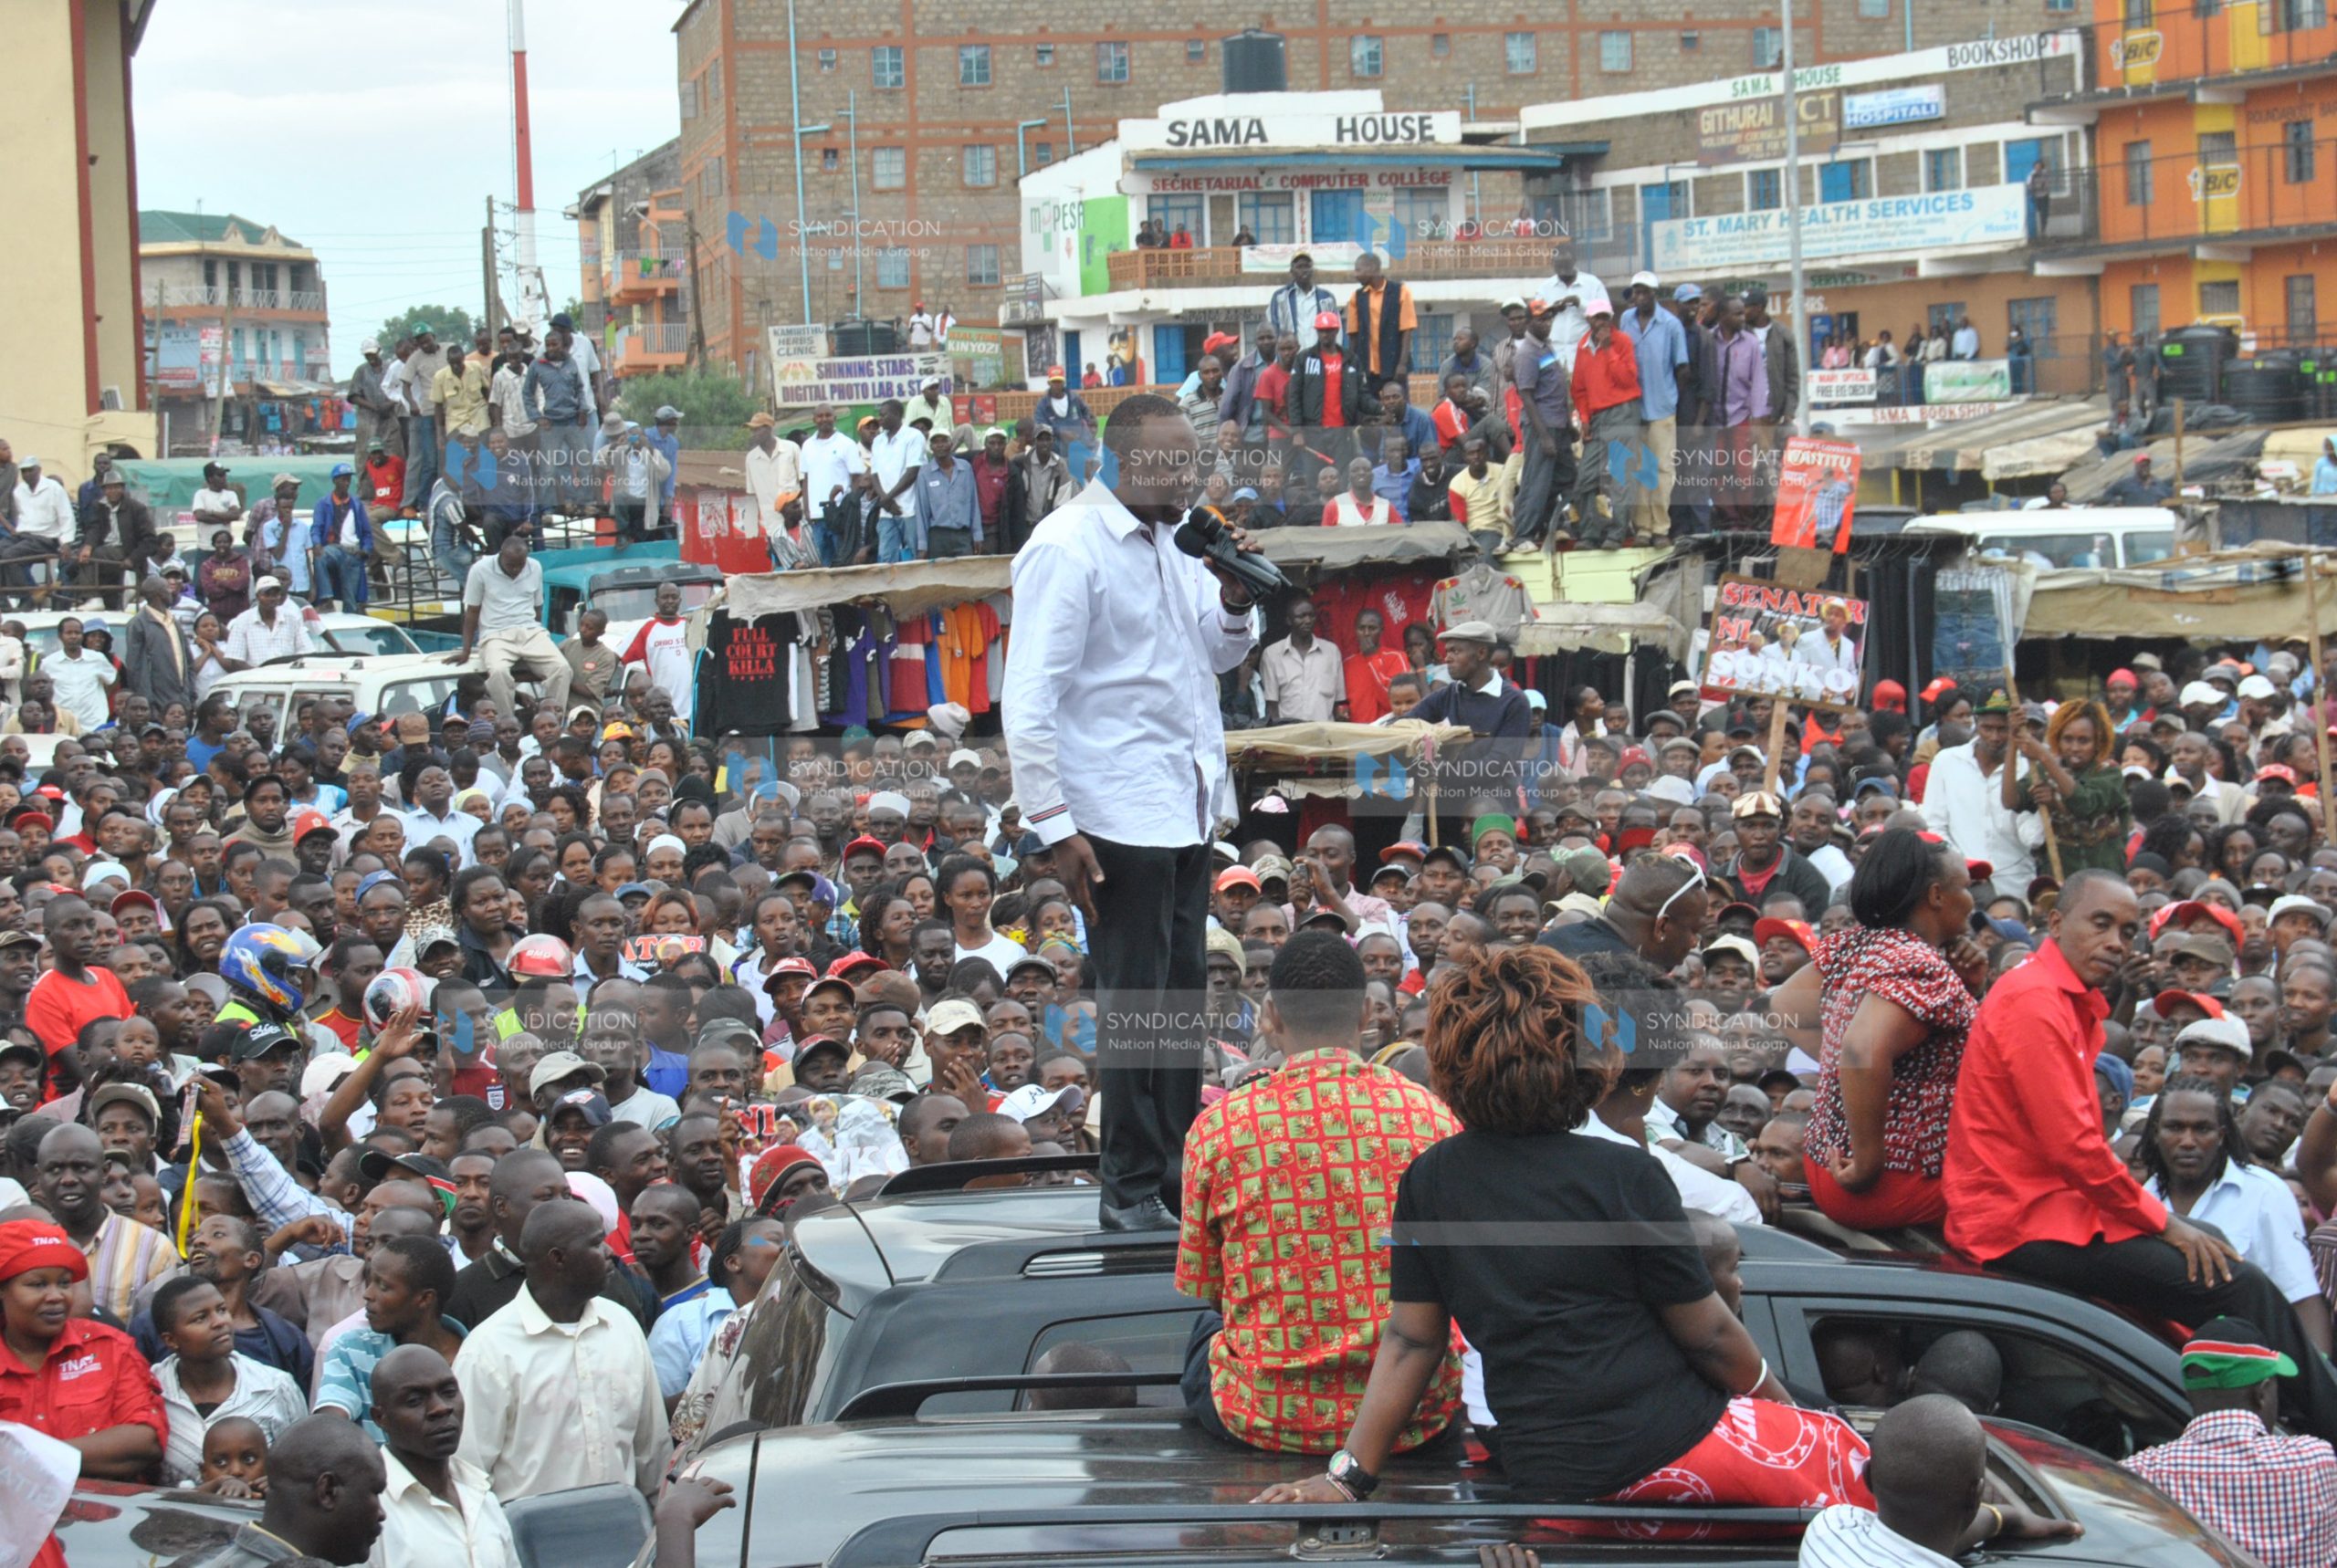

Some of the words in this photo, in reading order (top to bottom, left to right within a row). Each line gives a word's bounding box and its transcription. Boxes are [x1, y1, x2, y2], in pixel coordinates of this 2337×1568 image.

[1947, 35, 2048, 68] BOOKSHOP
[1732, 76, 1772, 98] SAMA
[1794, 67, 1840, 89] HOUSE
[1701, 102, 1774, 134] GITHURAI
[1845, 104, 1937, 126] HOSPITALI
[1166, 117, 1269, 147] SAMA
[1336, 114, 1436, 143] HOUSE
[1152, 174, 1264, 192] SECRETARIAL
[1280, 172, 1369, 189] COMPUTER
[1378, 170, 1453, 186] COLLEGE
[1683, 219, 1710, 238] ST.
[1717, 213, 1772, 234] MARY
[1868, 193, 1974, 219] SERVICES
[777, 346, 817, 357] CLINIC
[778, 337, 814, 347] HERBS
[948, 340, 1000, 354] KINYOZI
[816, 361, 875, 380] SHINNING
[876, 359, 915, 376] STARS
[781, 384, 828, 403] DIGITAL
[830, 382, 869, 402] PHOTO
[871, 380, 895, 399] LAB
[897, 383, 905, 396] &
[907, 378, 952, 397] STIO
[1872, 409, 1908, 423] SAMA
[1920, 402, 1996, 421] BOOKSHOP
[733, 627, 770, 643] FULL
[1716, 616, 1753, 642] NI
[726, 643, 778, 658] COURT
[728, 658, 775, 675] KILLA
[1710, 650, 1855, 693] SONKO
